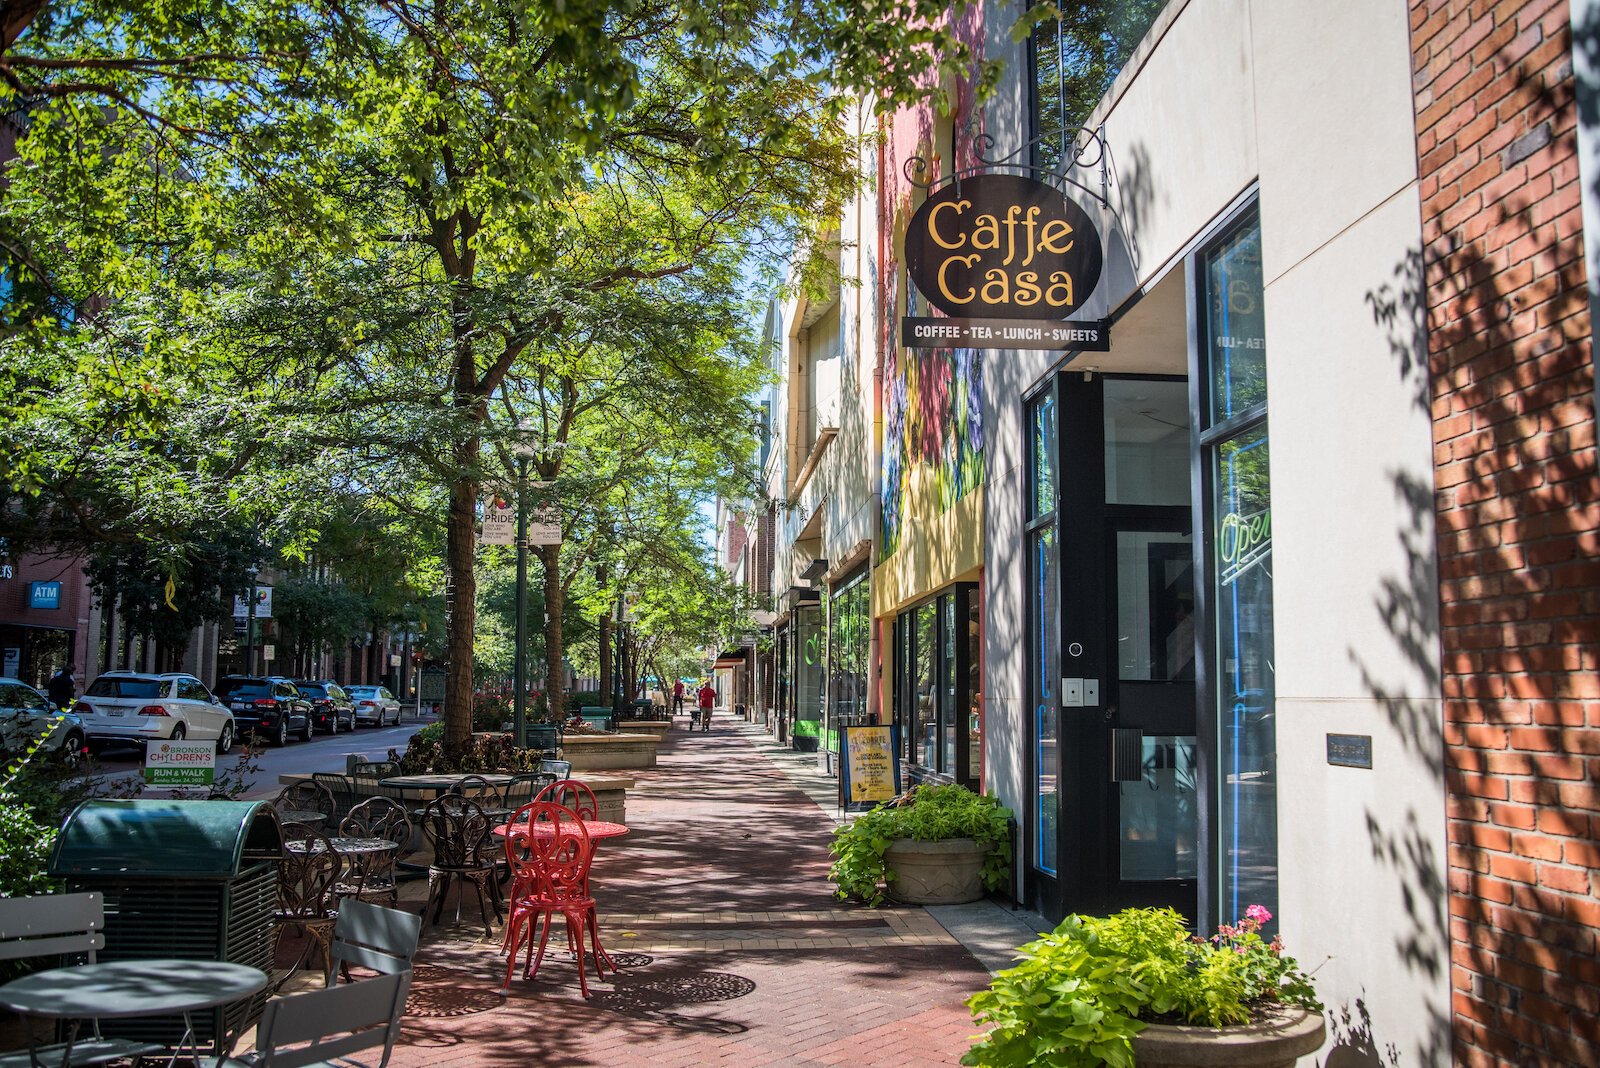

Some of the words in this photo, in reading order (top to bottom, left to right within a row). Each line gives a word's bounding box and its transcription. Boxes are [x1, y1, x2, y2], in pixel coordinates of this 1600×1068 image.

[927, 199, 1074, 267] Caffe
[937, 253, 1075, 307] Casa
[914, 325, 960, 339] COFFEE
[970, 326, 993, 339] TEA
[1003, 327, 1042, 341] LUNCH
[1052, 328, 1099, 342] SWEETS
[484, 514, 513, 523] PRIDE
[34, 586, 57, 598] ATM
[153, 769, 173, 777] RUN
[180, 769, 205, 777] WALK
